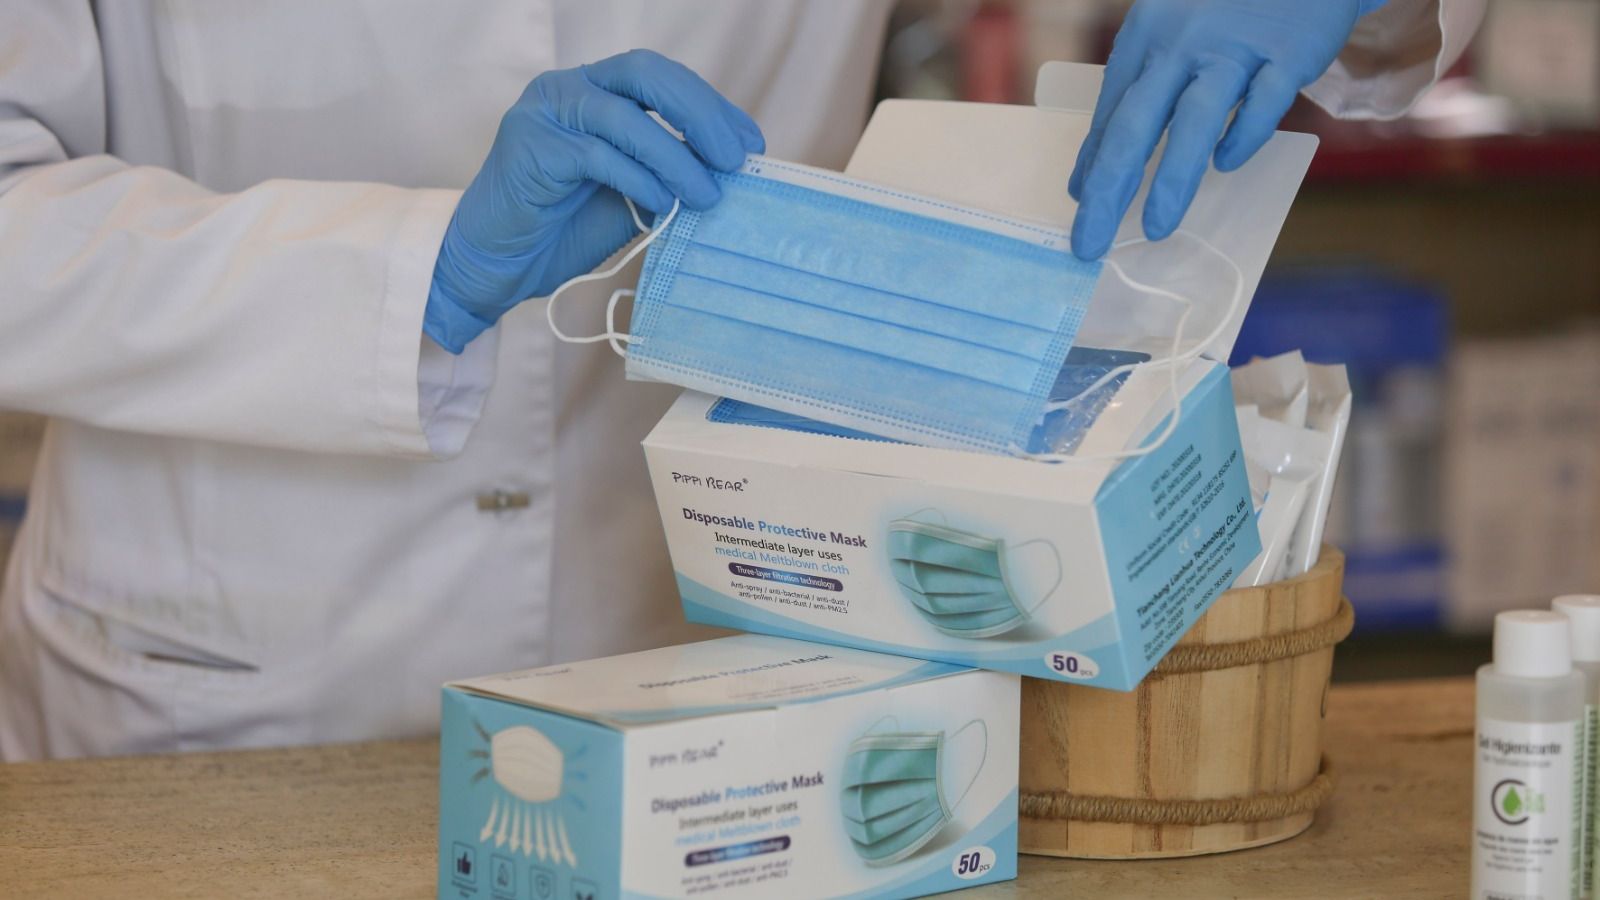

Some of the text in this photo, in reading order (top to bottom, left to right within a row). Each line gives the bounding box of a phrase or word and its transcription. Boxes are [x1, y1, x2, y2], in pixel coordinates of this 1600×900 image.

[682, 507, 868, 548] Disposable Protective Mask
[1194, 522, 1227, 560] Technology
[714, 531, 843, 562] Intermediate layer uses
[714, 545, 850, 575] medical Meltblown cloth
[735, 565, 771, 580] Three-layer
[800, 576, 836, 590] technology
[1053, 654, 1078, 673] 50
[651, 771, 824, 814] Disposable Protective Mask
[679, 801, 799, 830] Intermediate layer uses
[958, 851, 981, 875] 50
